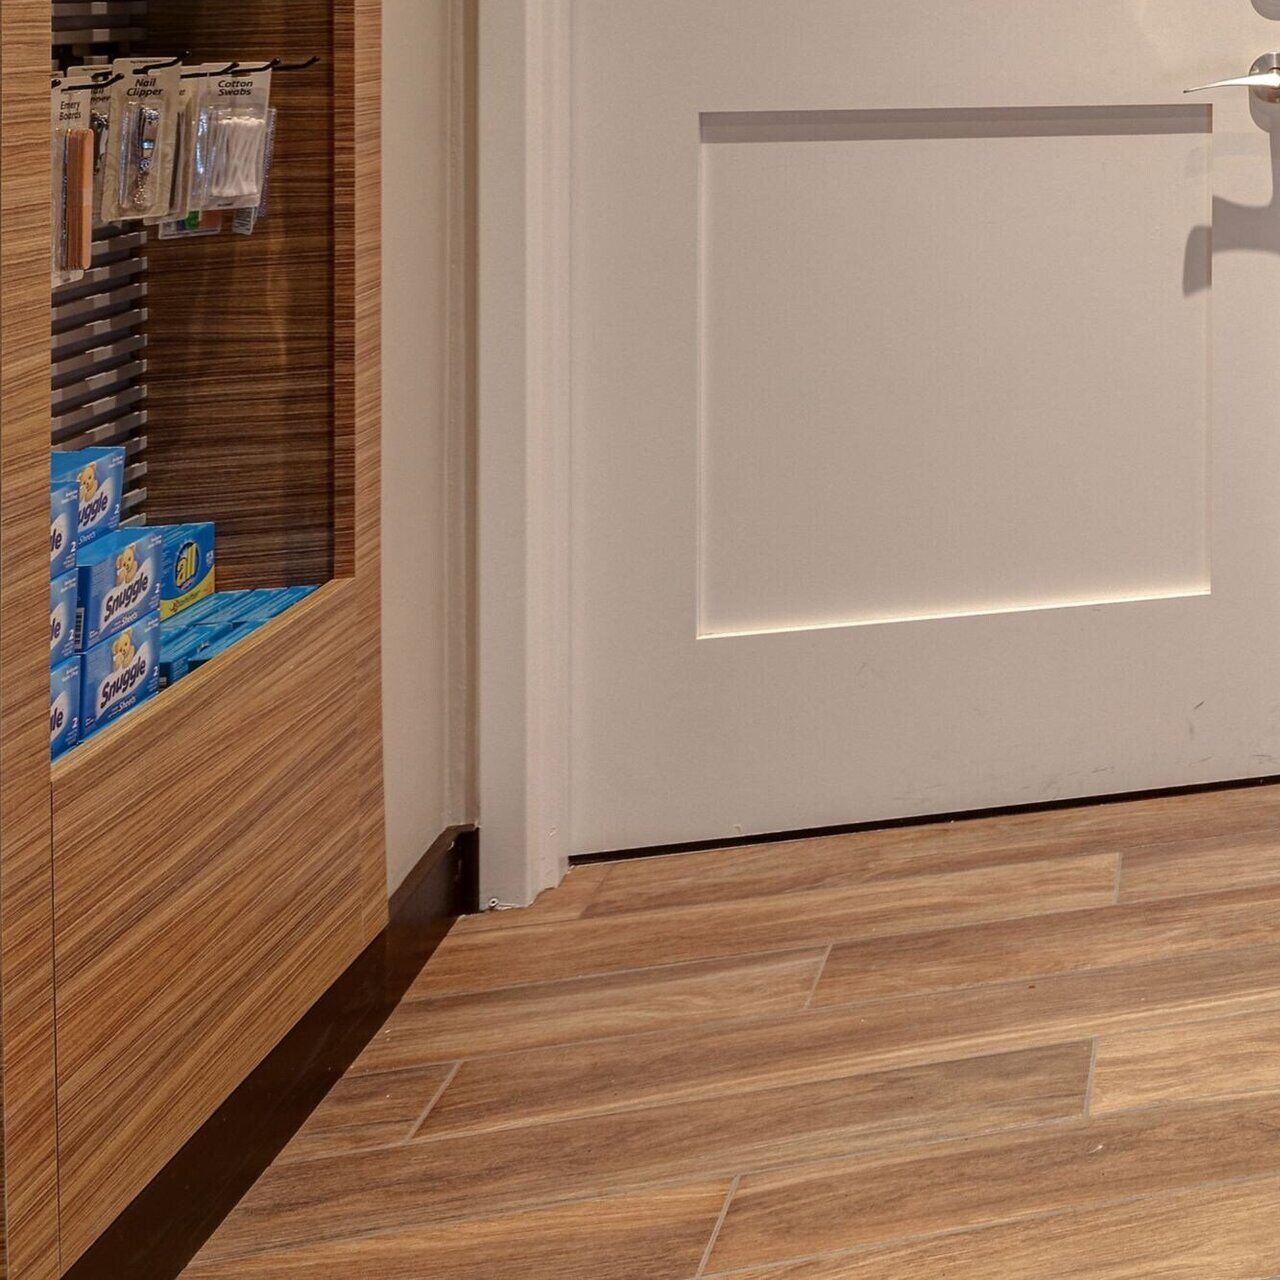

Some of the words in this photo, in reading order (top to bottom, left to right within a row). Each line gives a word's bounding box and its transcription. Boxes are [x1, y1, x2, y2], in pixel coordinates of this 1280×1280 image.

[60, 101, 81, 112] Emery
[126, 88, 163, 98] Clipper
[78, 491, 108, 527] uggle
[176, 542, 197, 588] all
[104, 572, 148, 622] Snuggle
[101, 656, 146, 709] Snuggle
